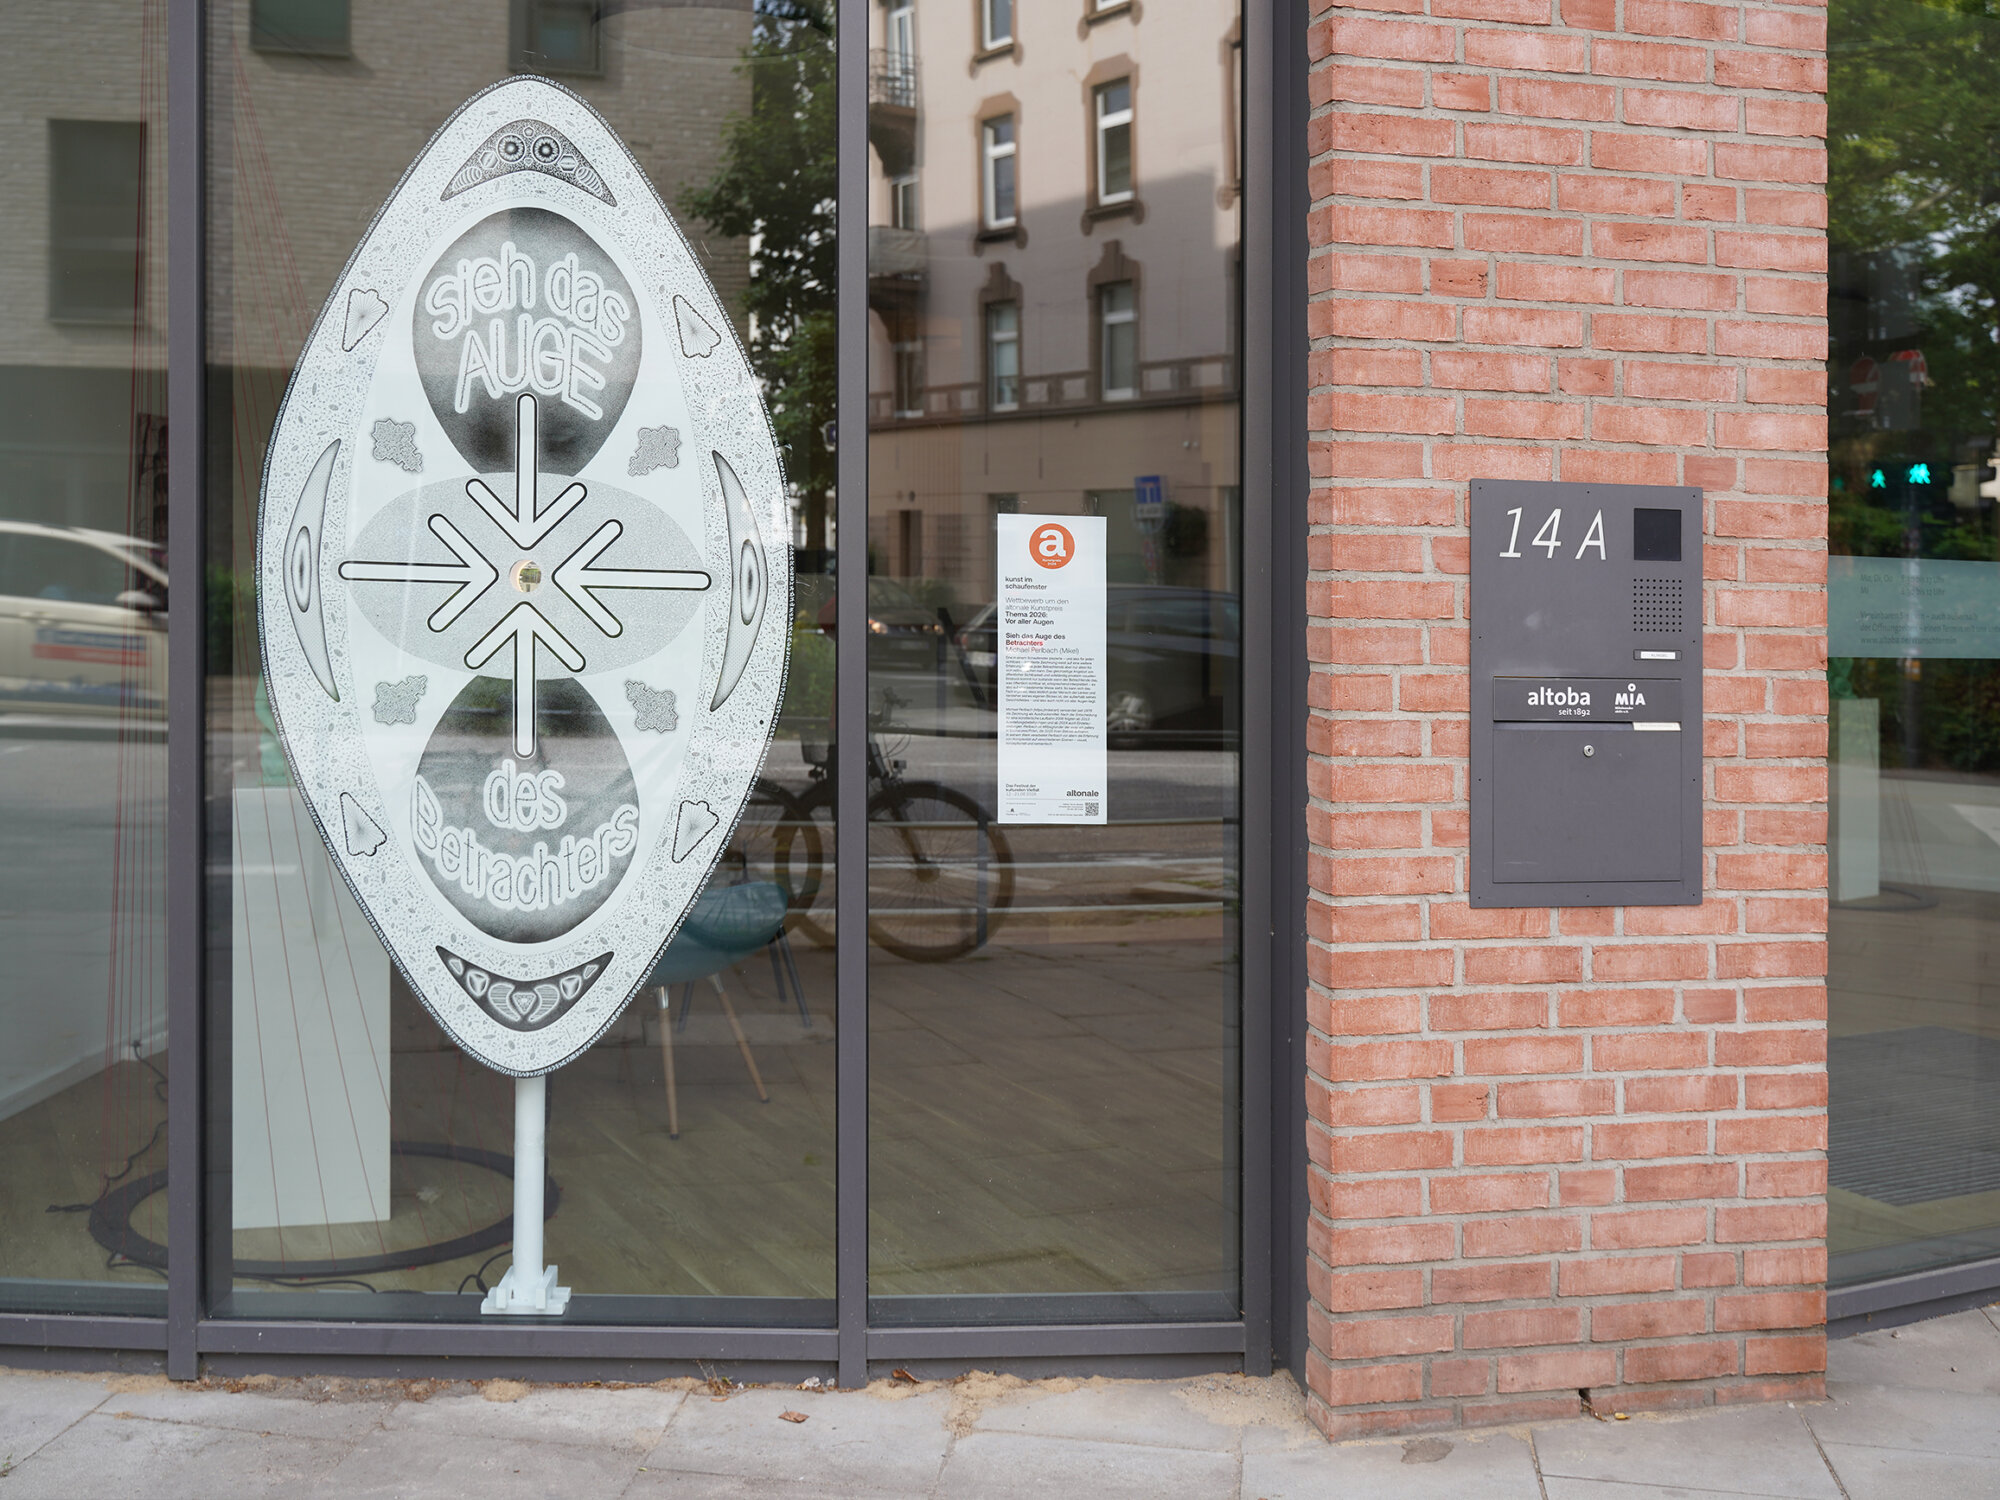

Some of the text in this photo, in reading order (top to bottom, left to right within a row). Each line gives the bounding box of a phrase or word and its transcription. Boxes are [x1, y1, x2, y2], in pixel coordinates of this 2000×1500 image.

[545, 252, 630, 347] das
[455, 313, 613, 420] AUGE
[1499, 506, 1606, 560] 14 A
[1035, 633, 1052, 641] Auge
[1527, 686, 1591, 706] altoba
[1558, 708, 1591, 717] seit 1892
[484, 758, 567, 832] des
[1066, 789, 1099, 797] altonale
[411, 775, 638, 911] Betrachters
